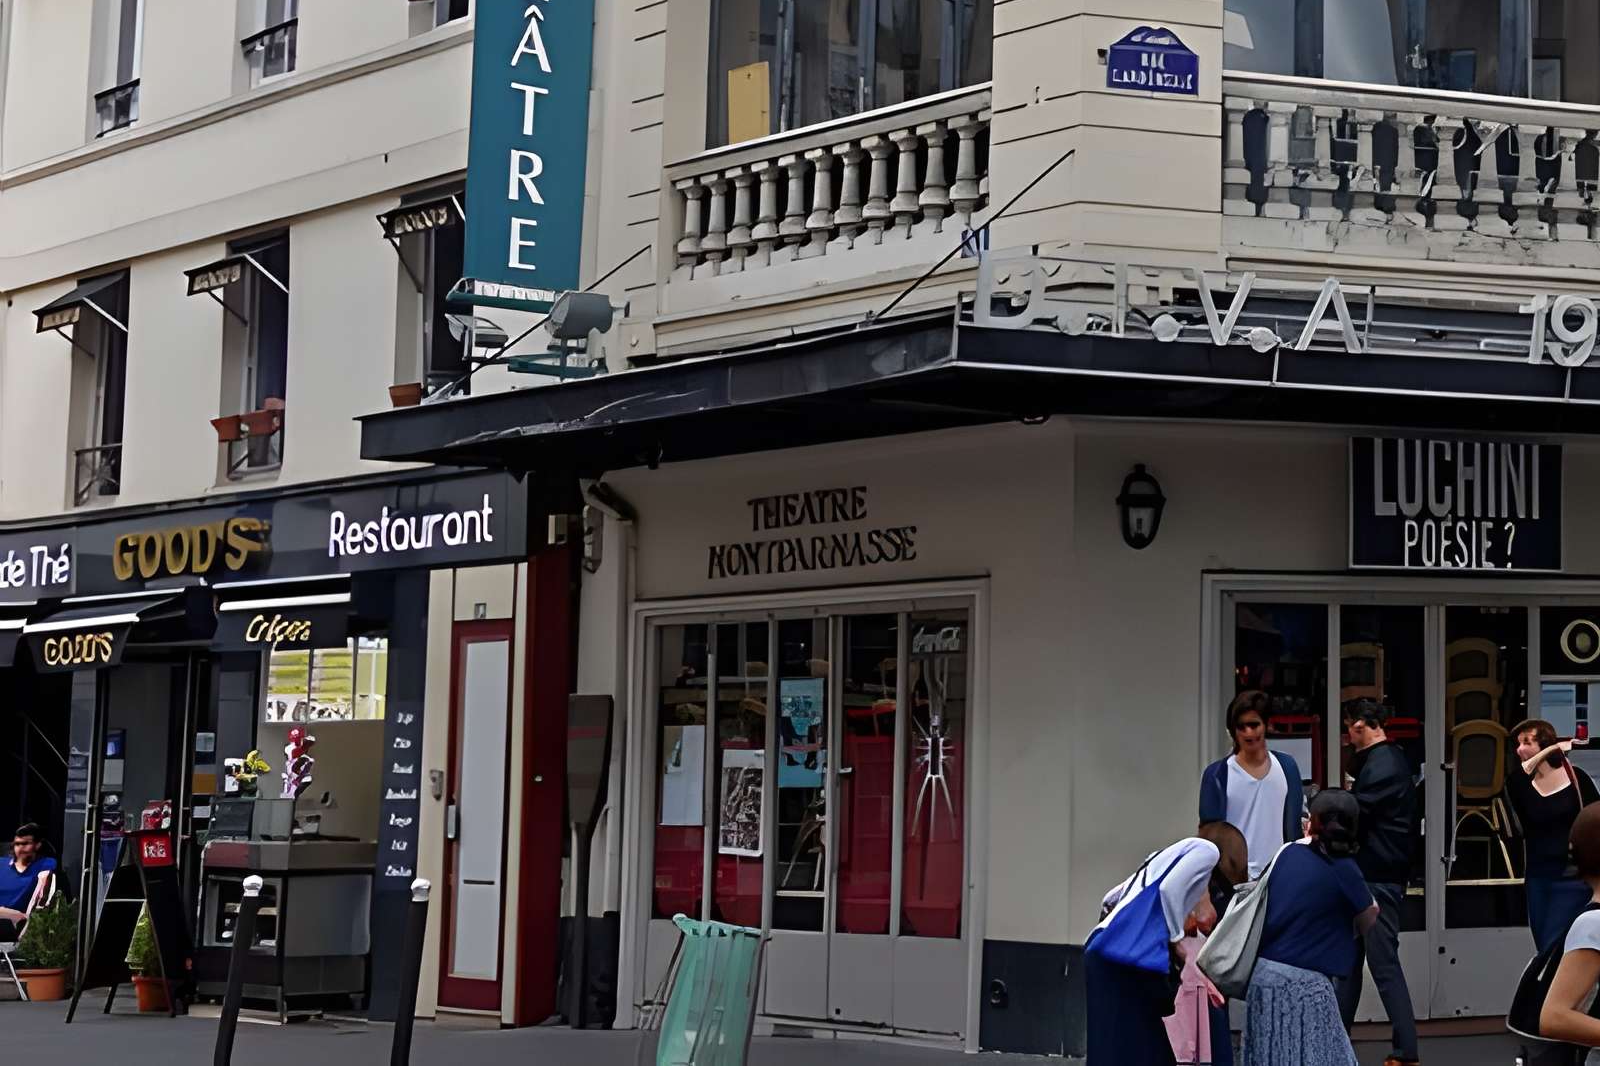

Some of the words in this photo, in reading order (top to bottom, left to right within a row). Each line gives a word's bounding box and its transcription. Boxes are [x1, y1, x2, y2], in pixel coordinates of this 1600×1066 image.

[1374, 437, 1541, 520] LUCHINI
[112, 516, 268, 582] GOOD'S
[328, 493, 494, 559] Restaurant
[29, 542, 71, 587] Thé
